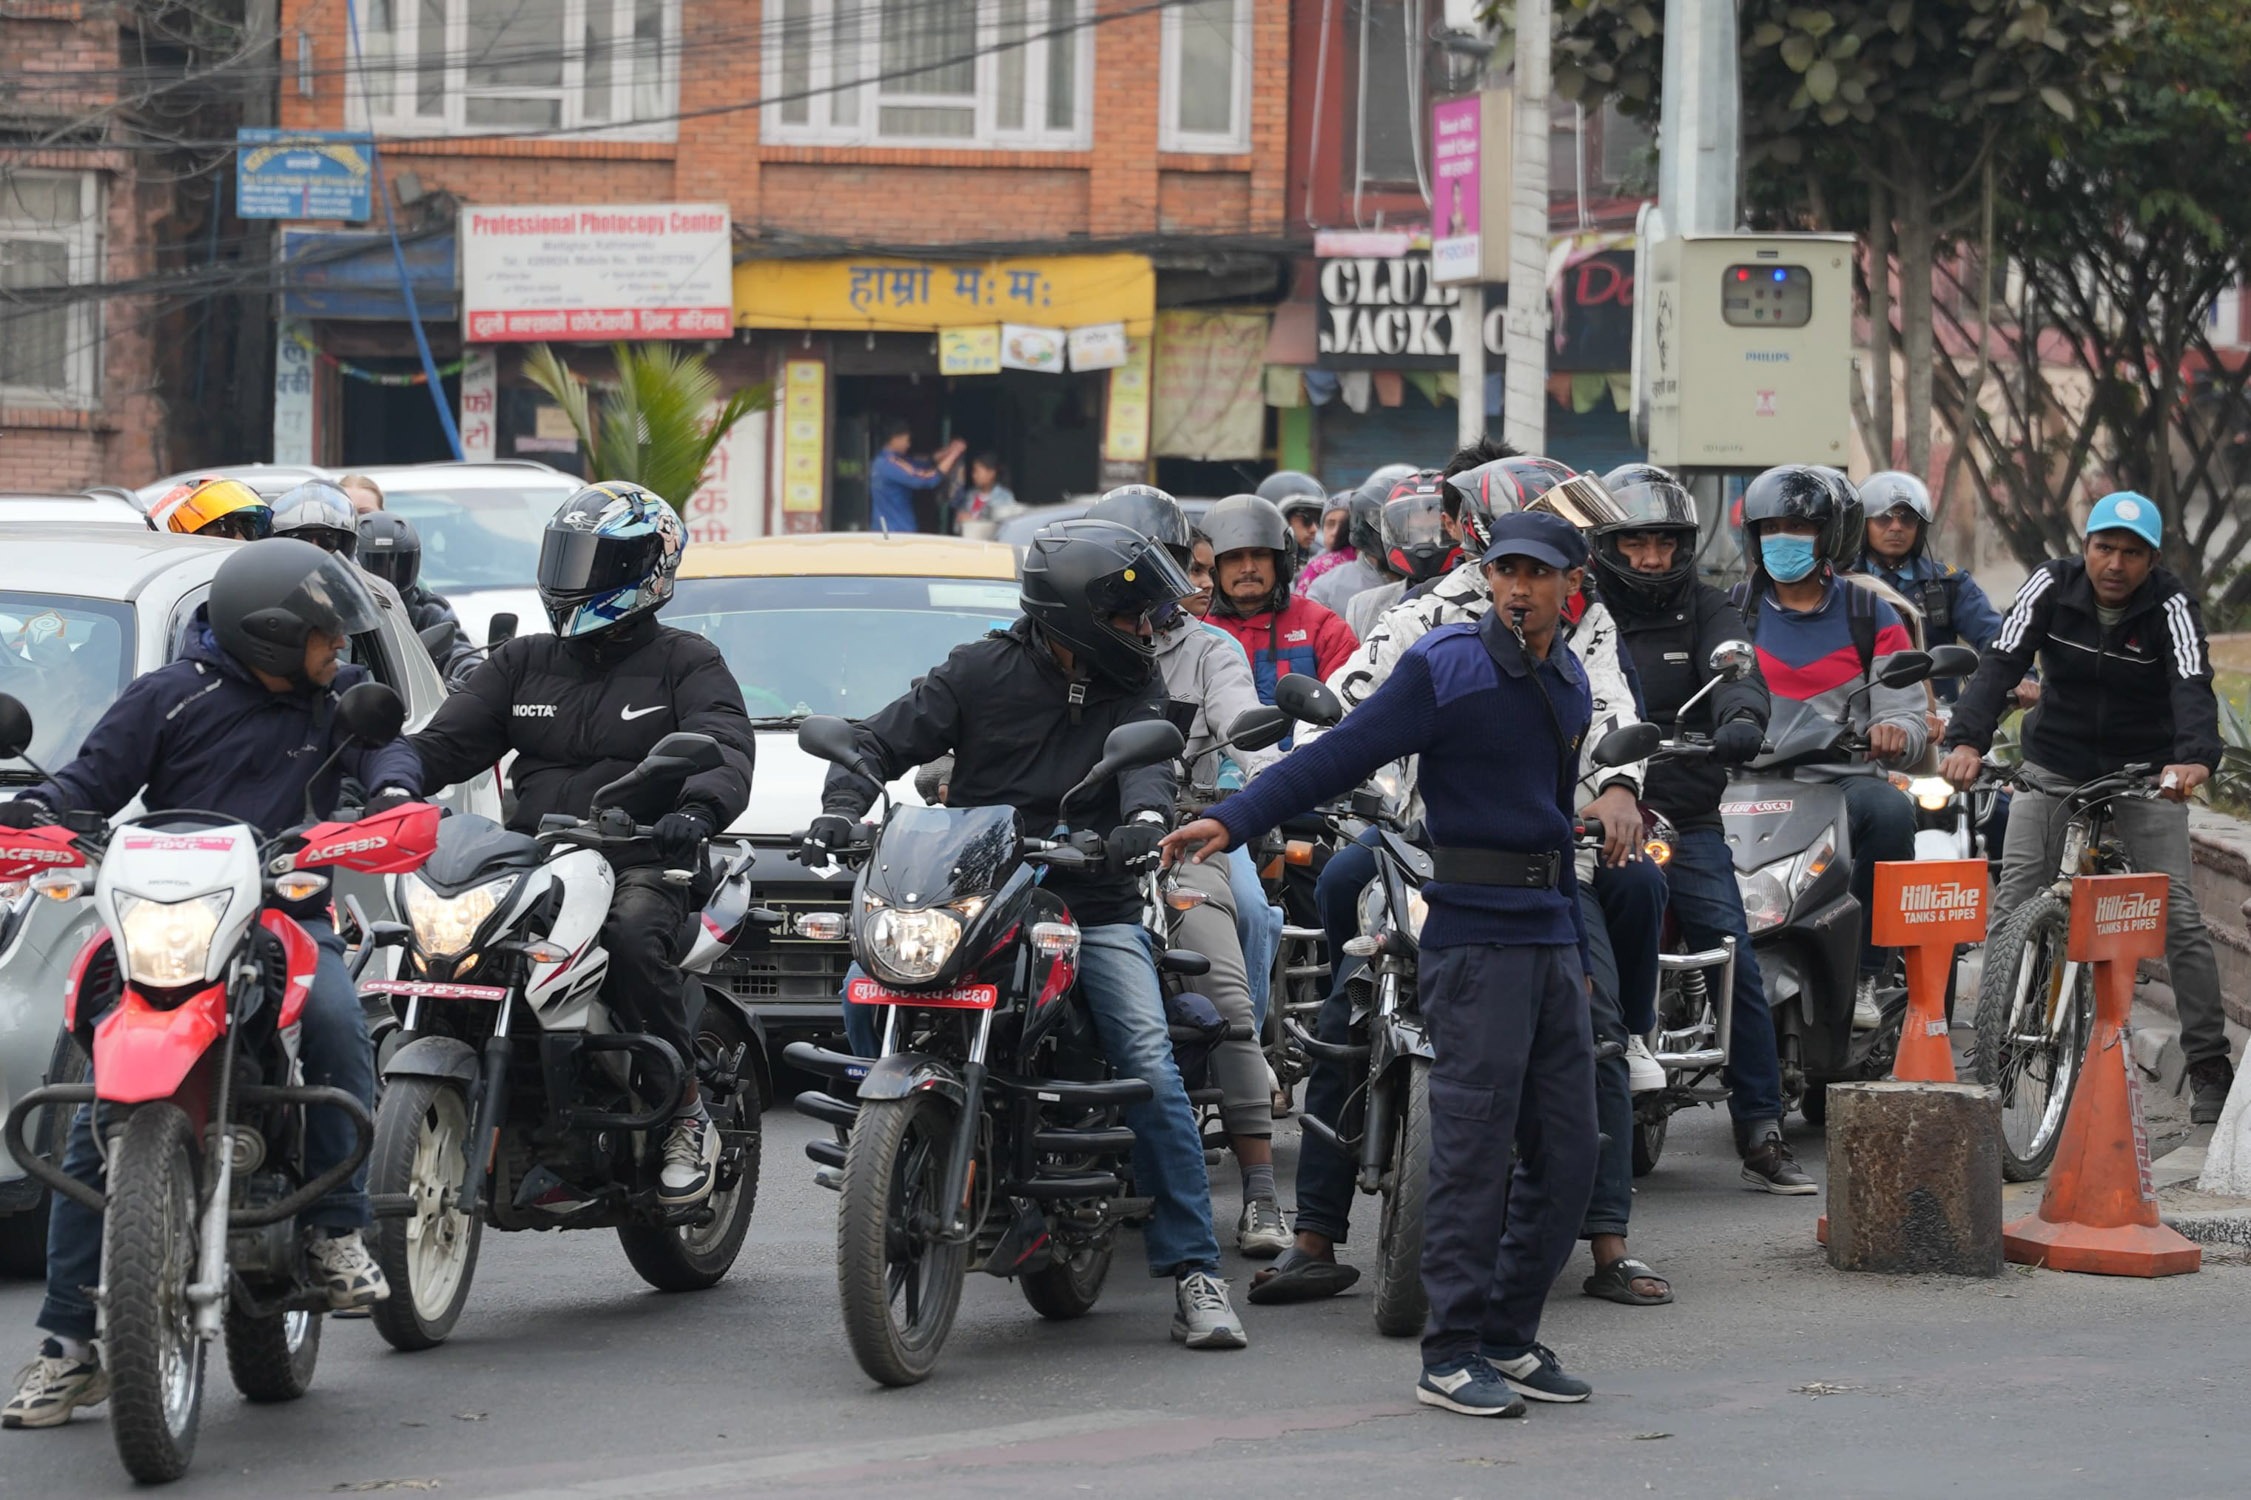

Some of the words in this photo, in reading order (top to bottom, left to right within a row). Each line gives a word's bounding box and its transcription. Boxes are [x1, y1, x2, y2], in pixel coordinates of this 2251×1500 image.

[473, 214, 576, 236] Professional
[581, 213, 665, 236] Photocopy
[670, 212, 725, 233] Center
[1745, 351, 1791, 363] PHILIPS
[305, 836, 388, 863] ACERBIS
[1900, 882, 1979, 911] Hilltake
[2095, 892, 2161, 922] Hilltake
[1904, 911, 1936, 924] TANKS
[1938, 910, 1946, 922] &
[1948, 908, 1976, 921] PIPES
[2096, 921, 2121, 936] TANKS
[2123, 920, 2129, 932] &
[2131, 918, 2157, 931] PIPES
